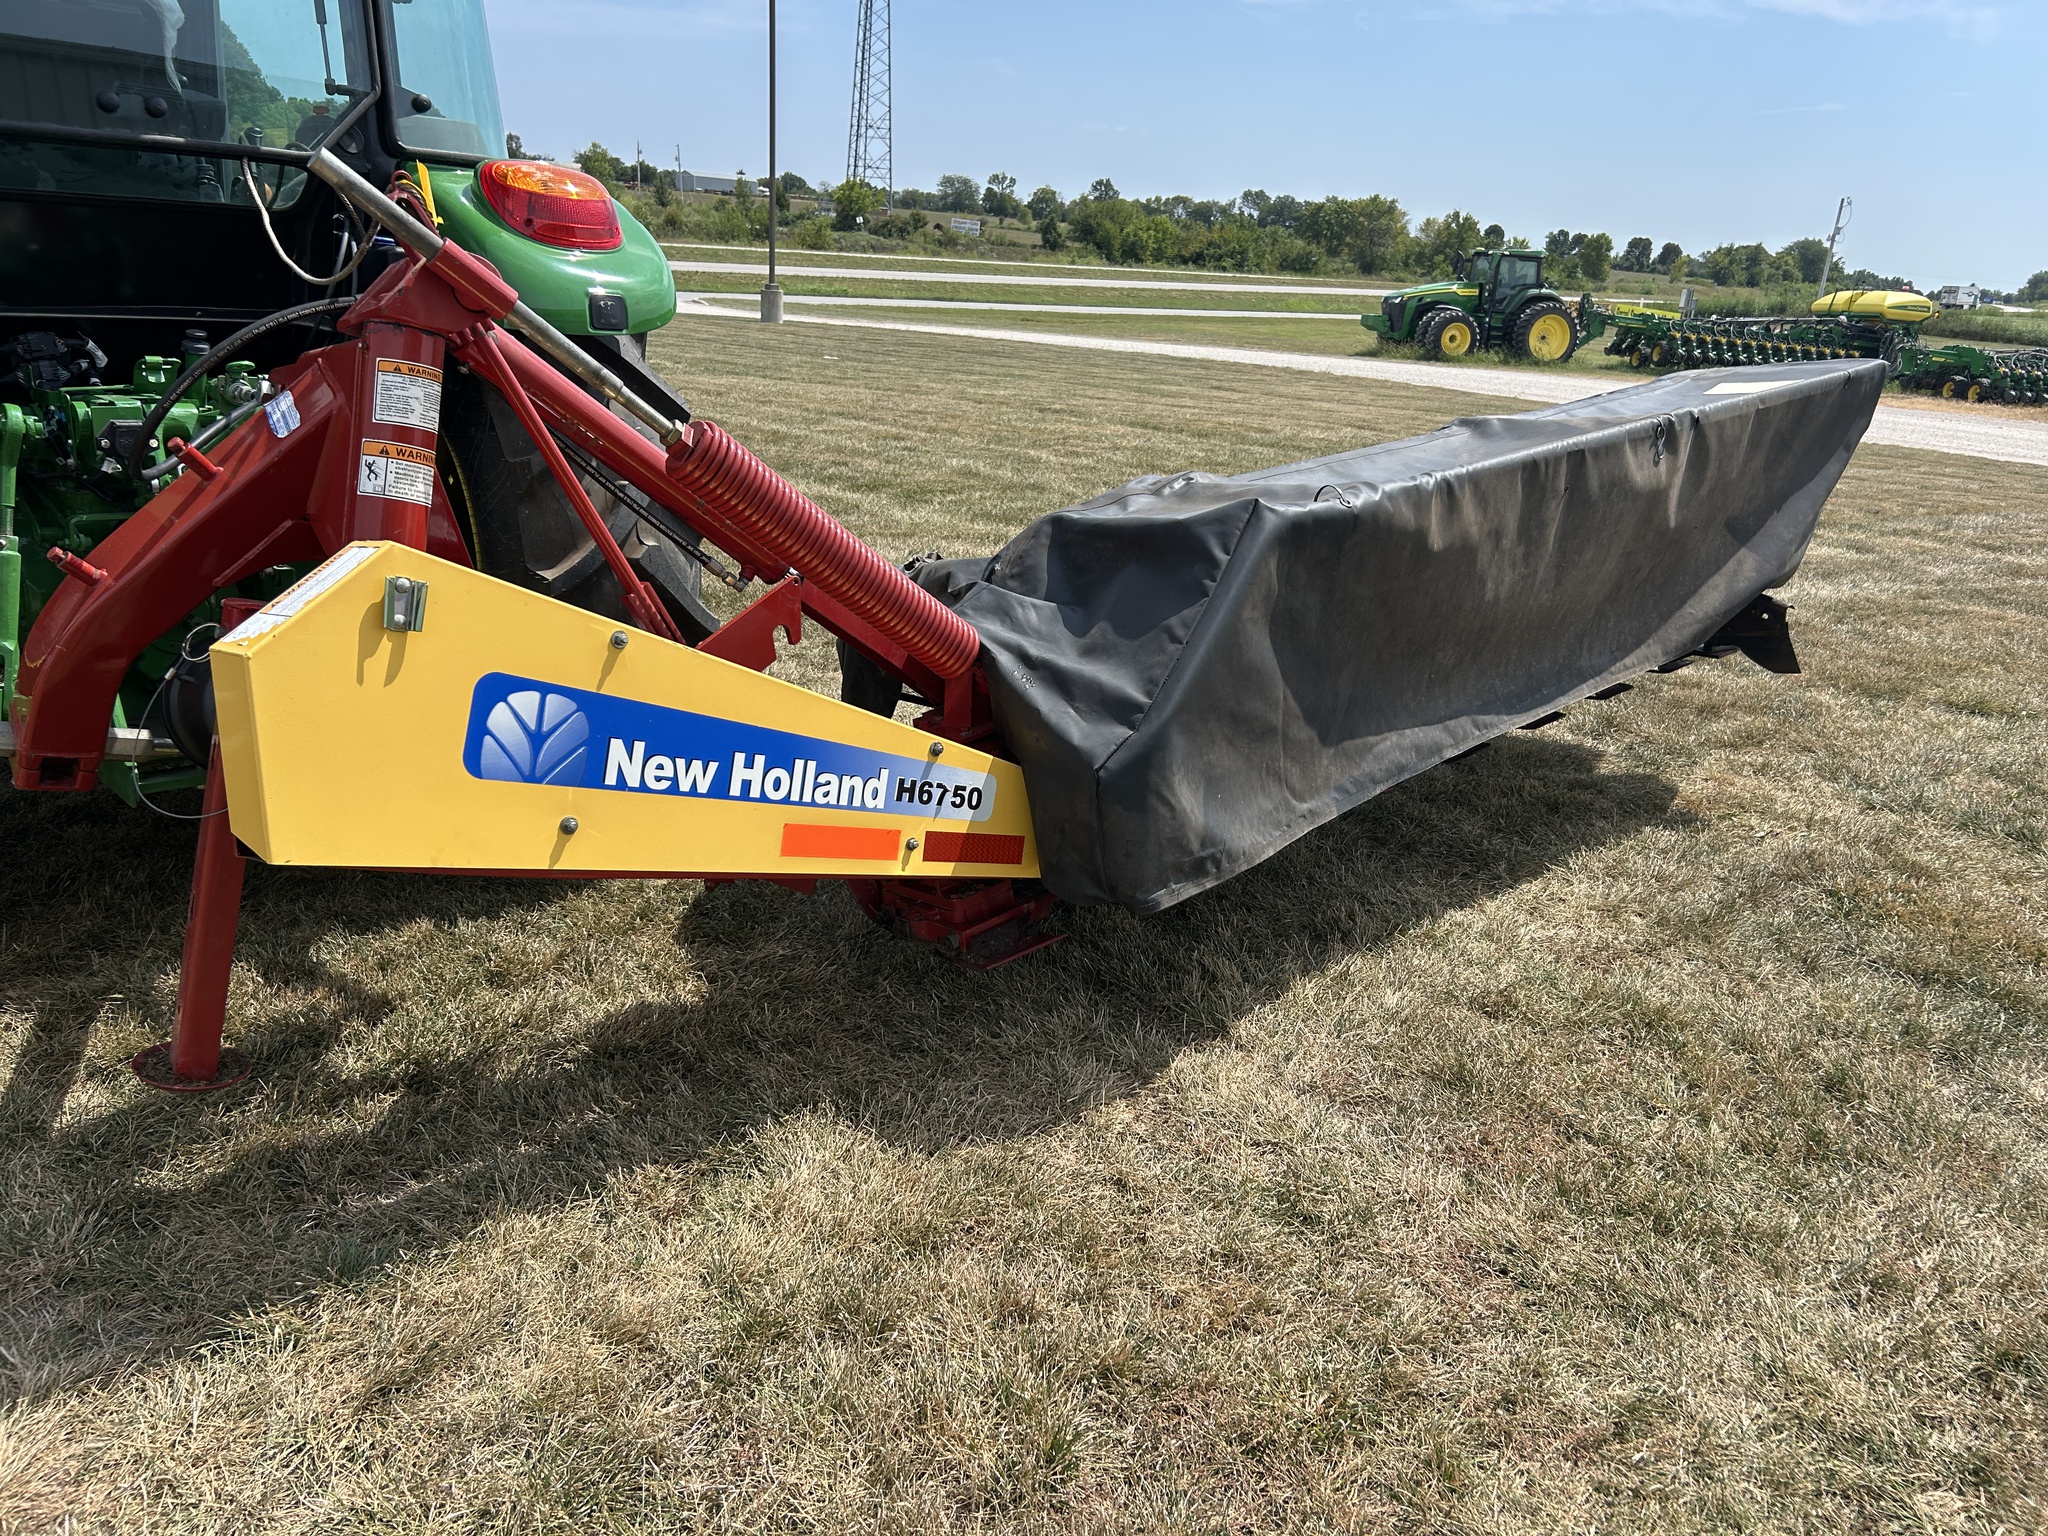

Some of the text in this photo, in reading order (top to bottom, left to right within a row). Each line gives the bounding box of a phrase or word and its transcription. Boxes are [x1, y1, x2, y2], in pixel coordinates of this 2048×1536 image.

[395, 447, 435, 465] WARNIN
[603, 738, 983, 811] New Holland H6750
